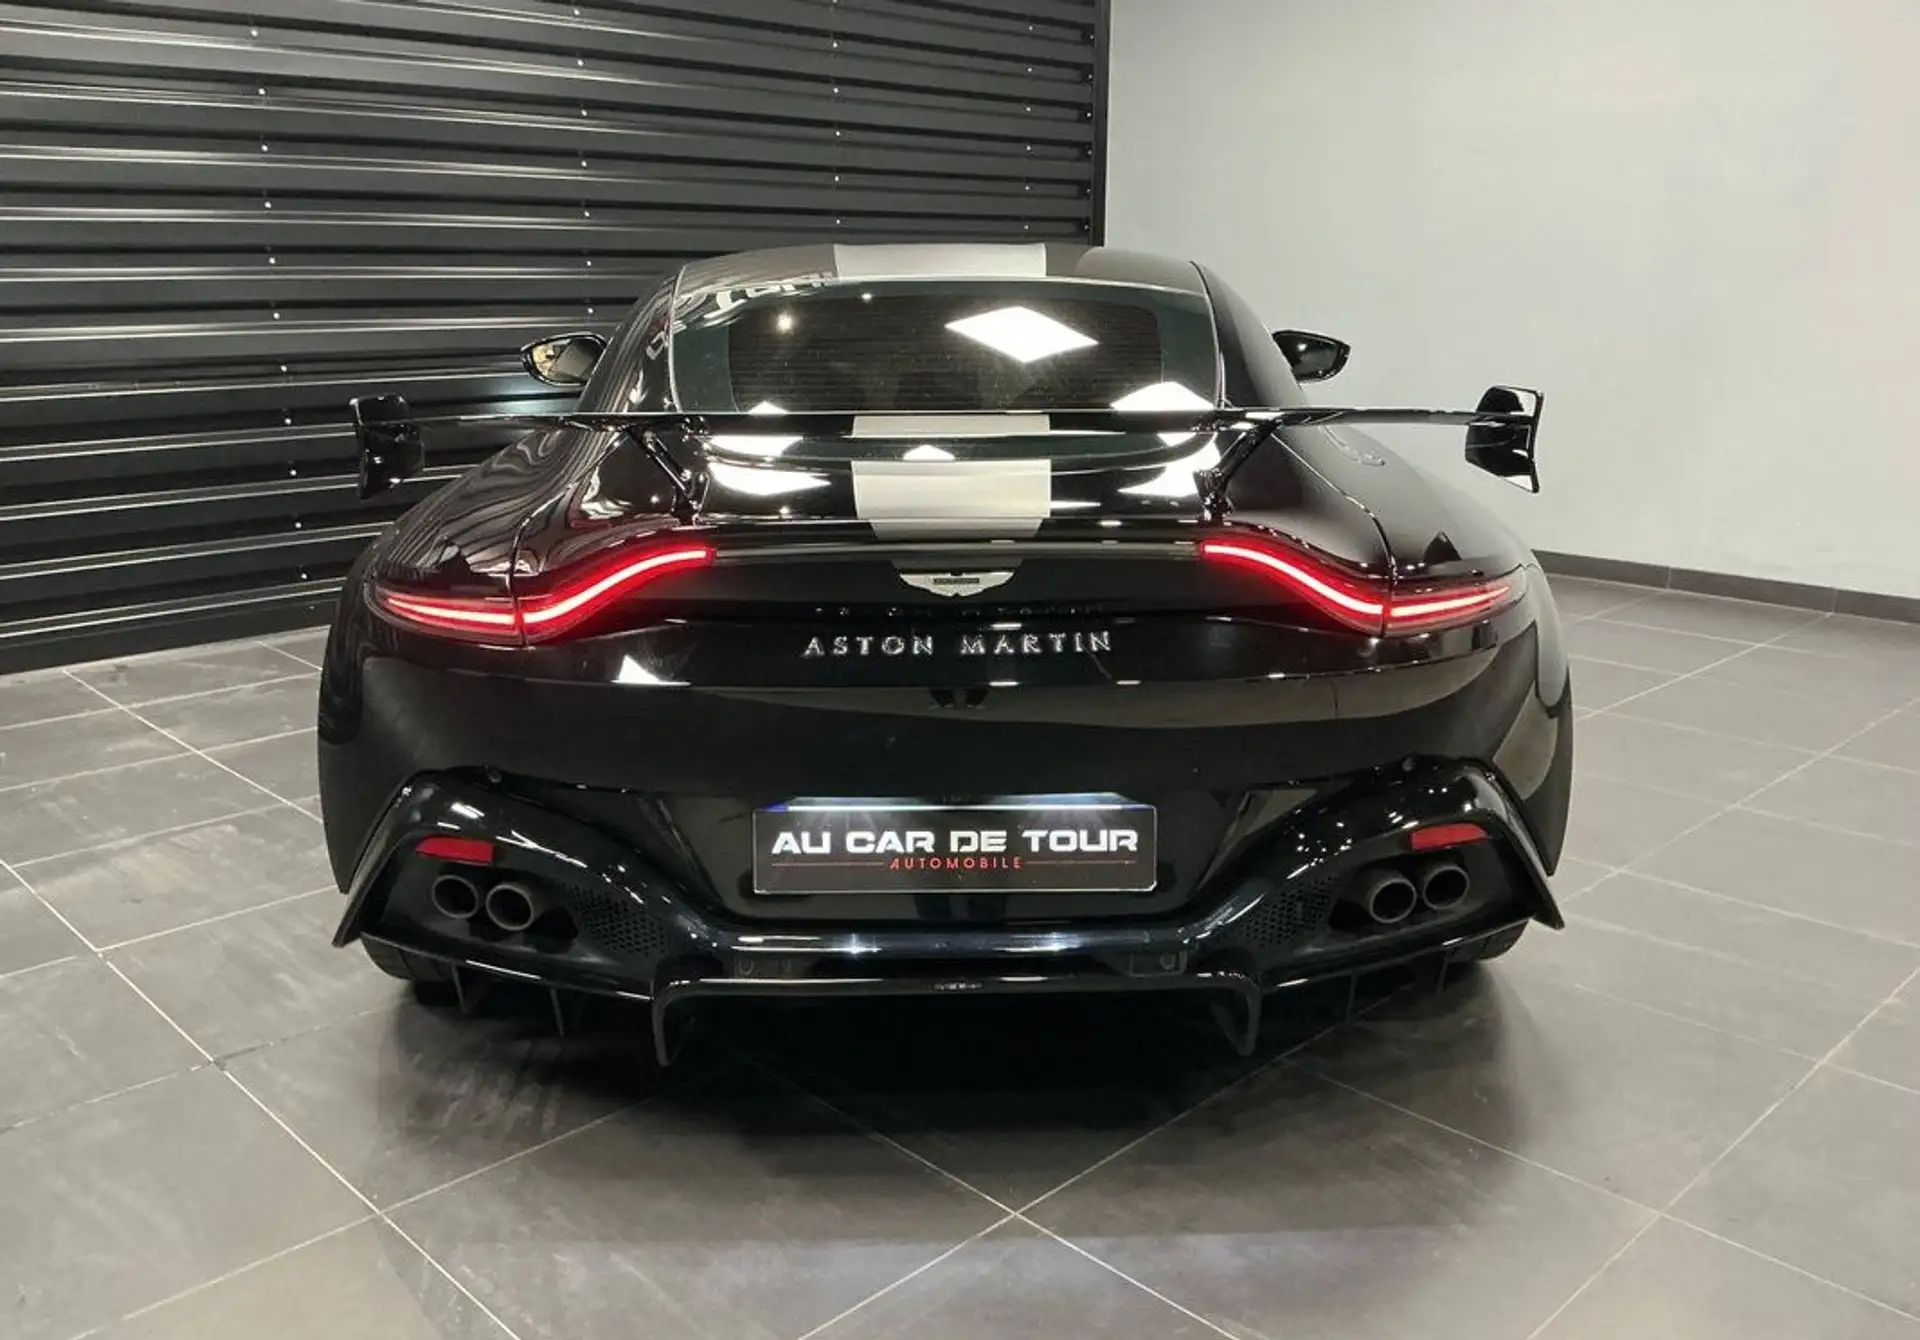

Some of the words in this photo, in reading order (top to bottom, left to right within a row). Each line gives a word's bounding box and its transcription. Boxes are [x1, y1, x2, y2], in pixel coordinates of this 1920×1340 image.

[803, 635, 934, 657] ASTON
[959, 630, 1112, 655] MARTIN
[771, 831, 831, 854] AU
[845, 830, 935, 854] CAR
[950, 830, 1007, 852] DE
[1022, 829, 1138, 852] TOUR
[889, 857, 1021, 871] AUTOMOBILE
